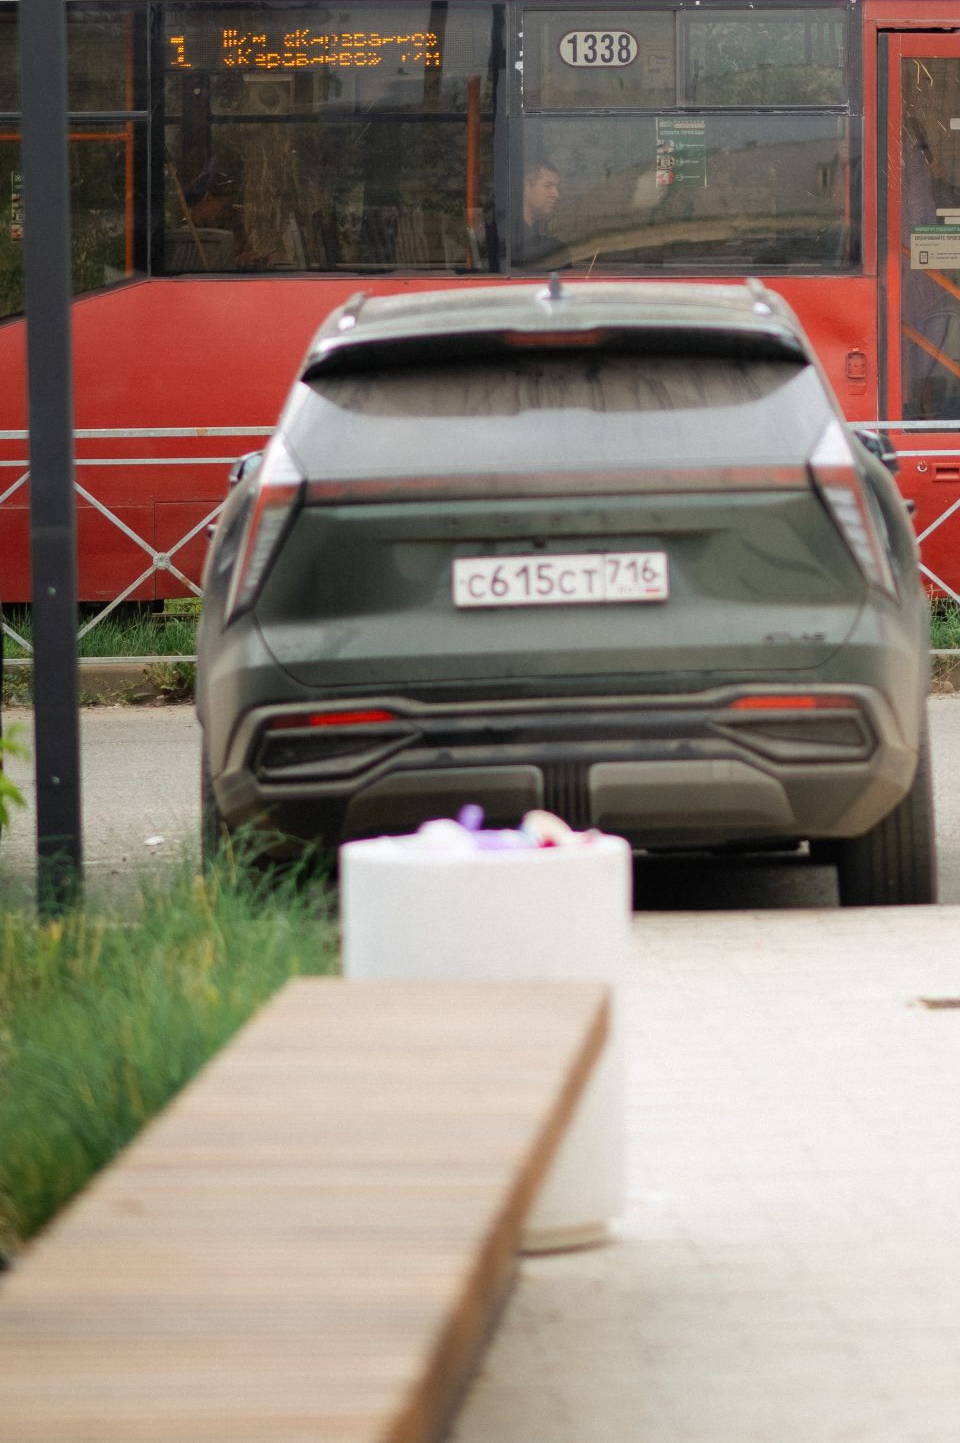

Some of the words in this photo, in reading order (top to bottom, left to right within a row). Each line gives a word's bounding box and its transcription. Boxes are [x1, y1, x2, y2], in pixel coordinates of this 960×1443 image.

[170, 35, 192, 68] 1
[567, 34, 631, 63] 1338
[607, 557, 658, 584] 716
